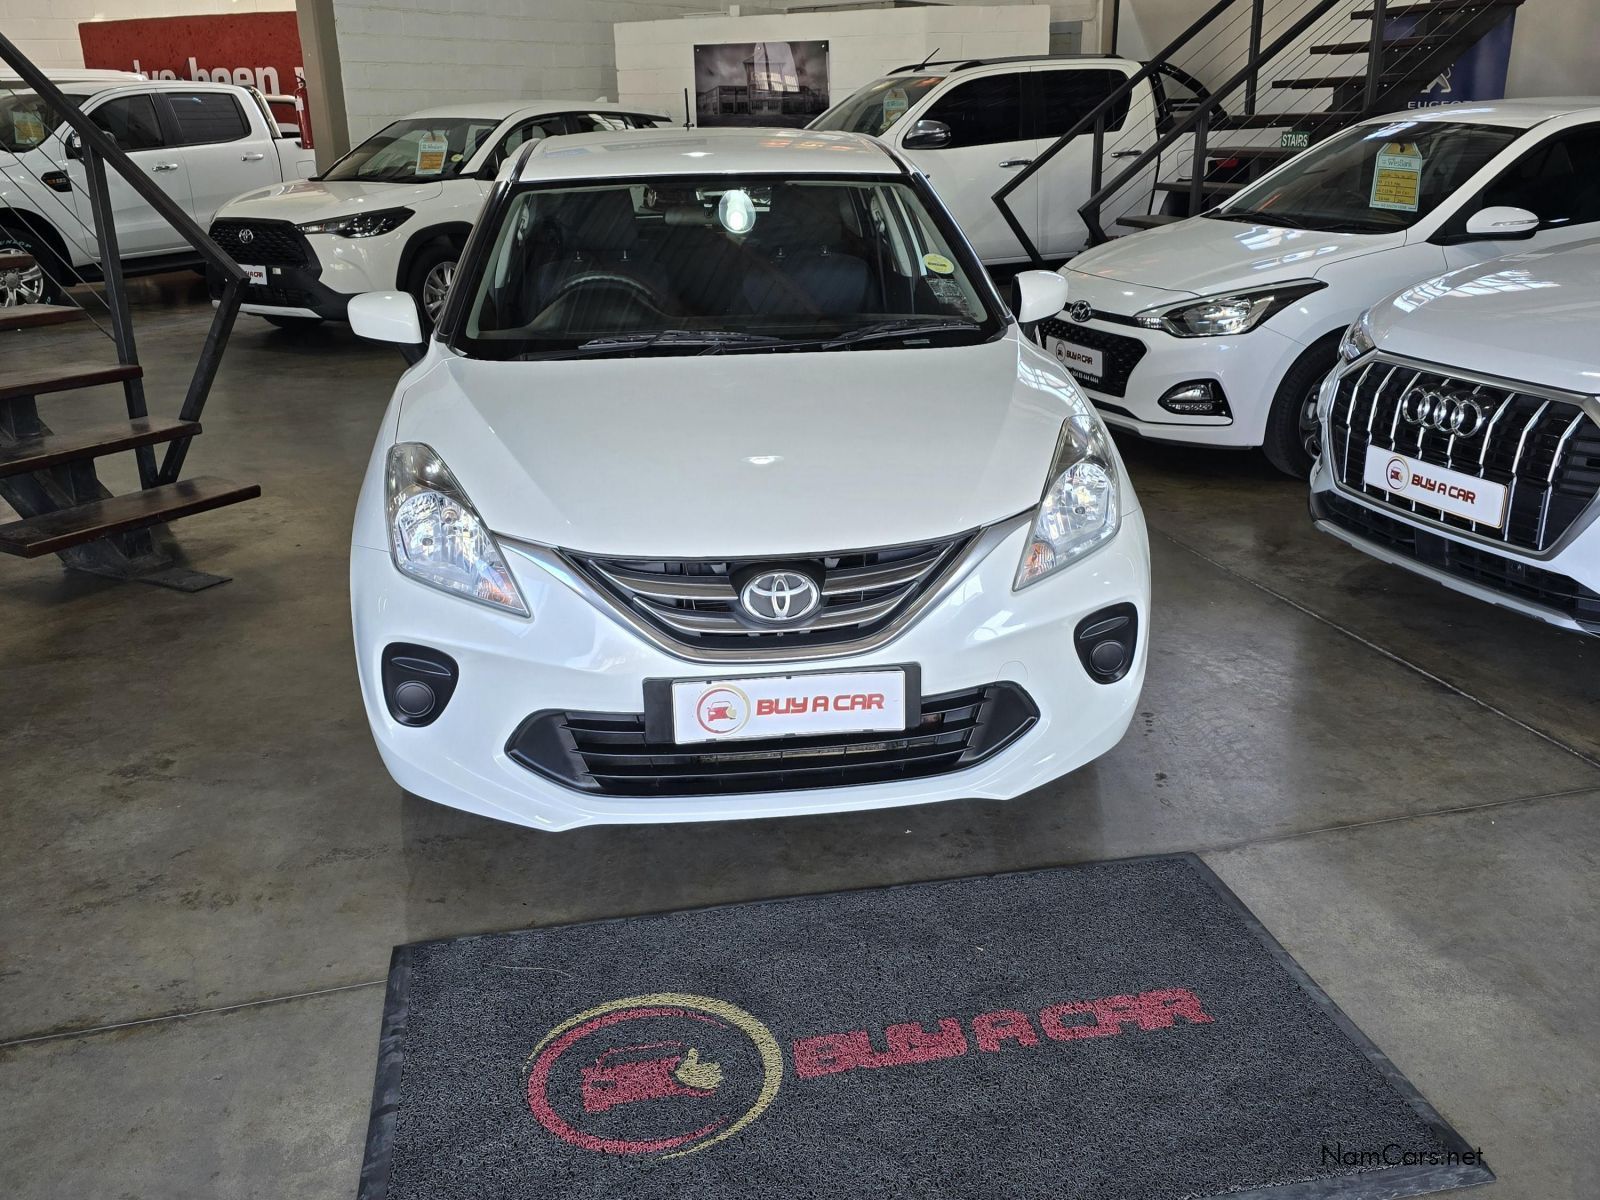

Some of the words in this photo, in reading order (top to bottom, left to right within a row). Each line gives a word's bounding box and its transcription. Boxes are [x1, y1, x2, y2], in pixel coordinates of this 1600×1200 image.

[1282, 134, 1308, 147] STAIRS
[1411, 473, 1436, 492] BUY
[1437, 483, 1447, 495] A
[1448, 486, 1476, 504] CAR
[756, 696, 808, 716] BUY
[811, 696, 829, 713] A
[833, 693, 885, 711] CAR
[793, 1016, 967, 1079] BUY
[978, 1009, 1037, 1052] A
[1038, 987, 1215, 1041] CAR
